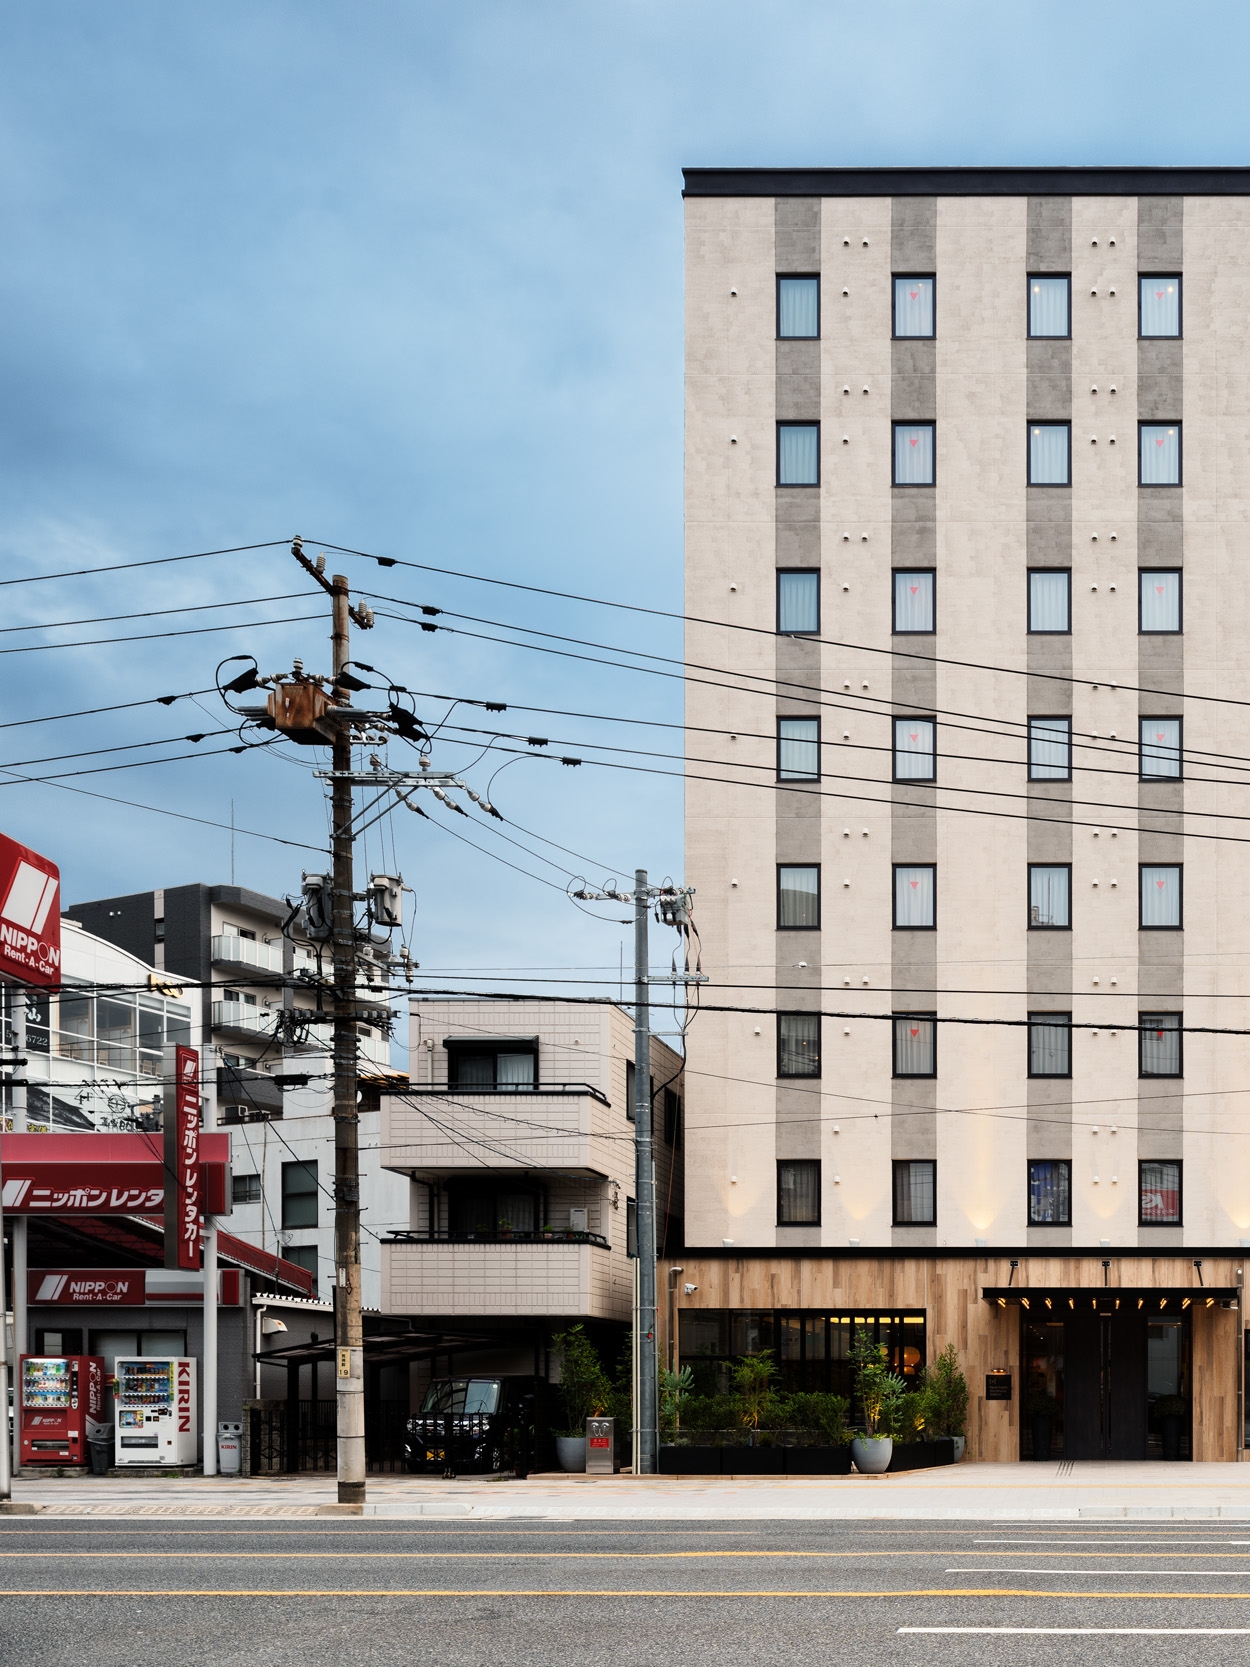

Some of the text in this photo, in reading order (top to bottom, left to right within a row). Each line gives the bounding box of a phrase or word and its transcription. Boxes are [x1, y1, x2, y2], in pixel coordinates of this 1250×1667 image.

[0, 923, 61, 967] NIPPON
[29, 1188, 165, 1207] ニッポンレンタ
[69, 1281, 129, 1293] NIPPON
[89, 1361, 97, 1414] NIPPON
[178, 1361, 190, 1432] KIRIN
